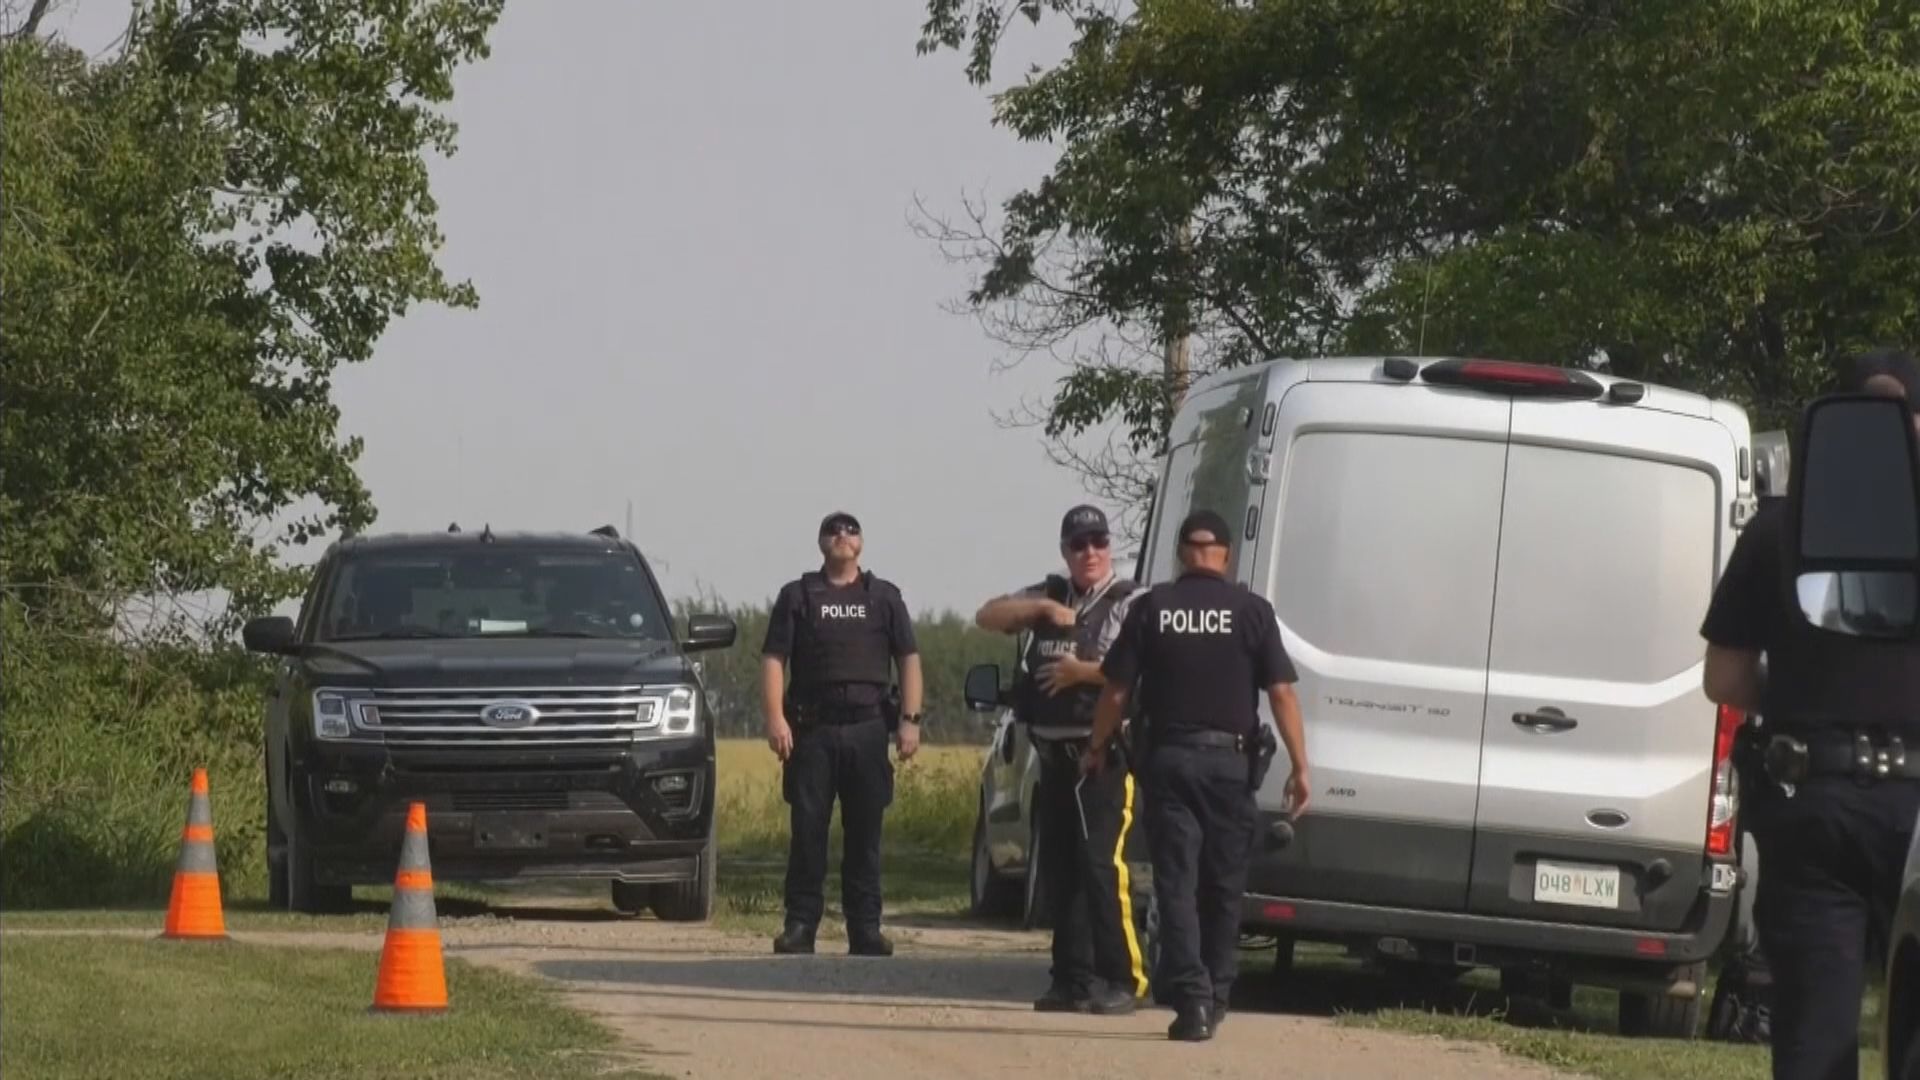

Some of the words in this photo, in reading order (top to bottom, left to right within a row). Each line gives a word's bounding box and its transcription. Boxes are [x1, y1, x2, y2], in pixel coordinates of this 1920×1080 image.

[821, 605, 866, 618] POLICE
[1160, 609, 1232, 633] POLICE
[1326, 786, 1357, 798] AWD
[1539, 872, 1571, 894] 048
[1583, 875, 1616, 897] LXW
